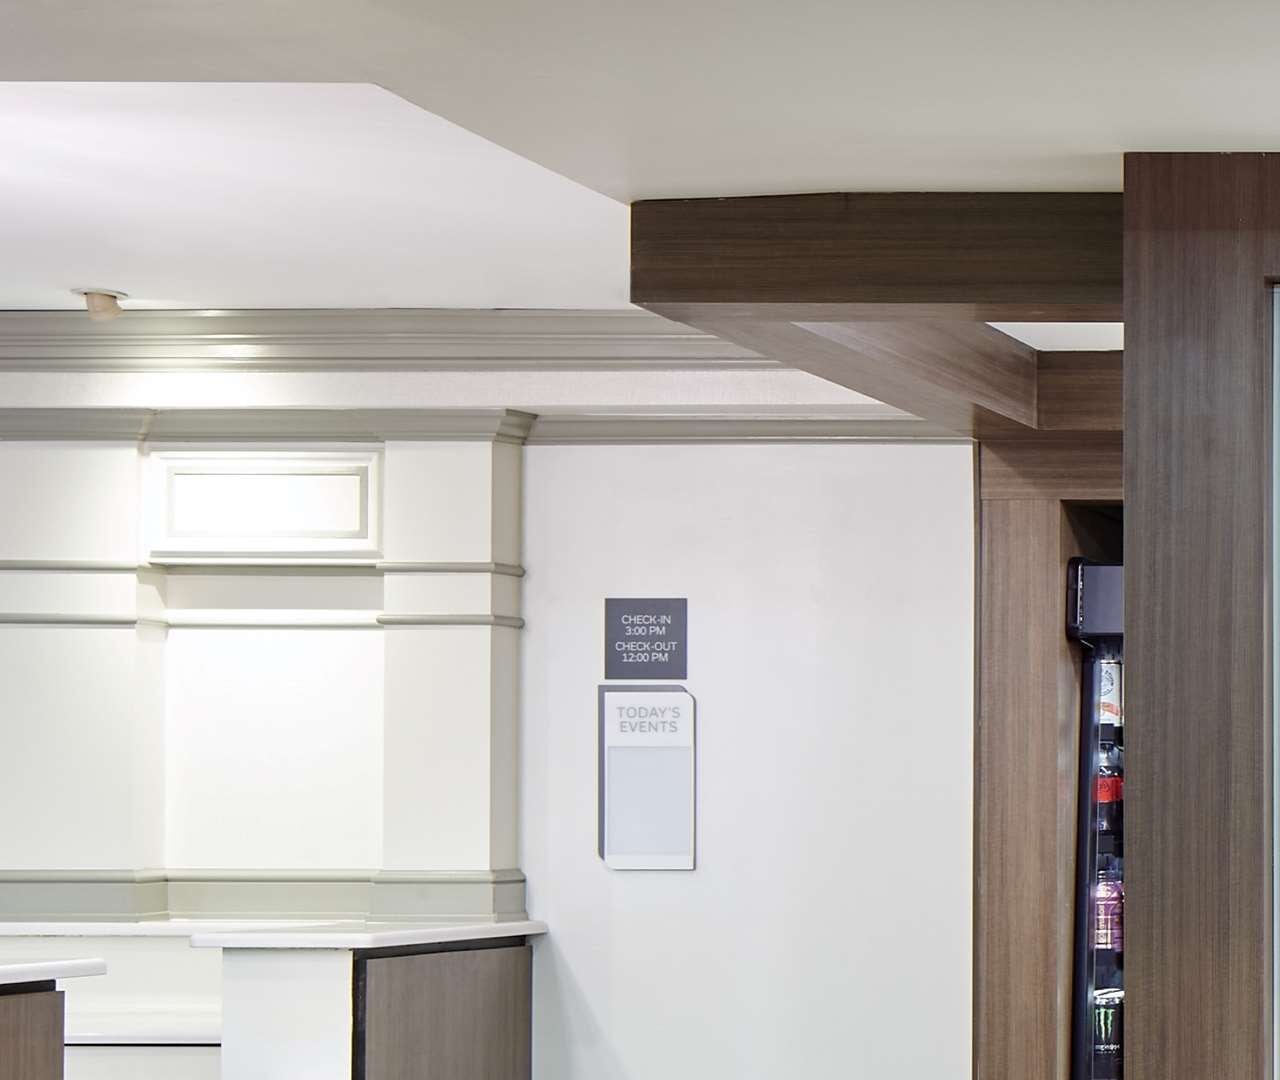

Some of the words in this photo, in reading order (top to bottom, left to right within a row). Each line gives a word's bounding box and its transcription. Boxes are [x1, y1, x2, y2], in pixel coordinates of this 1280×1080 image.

[621, 615, 672, 625] CHECK-IN
[625, 626, 647, 636] 3:00
[649, 626, 666, 636] PM
[615, 641, 678, 652] CHECK-OUT
[622, 653, 649, 663] 12:00
[651, 653, 669, 663] PM
[617, 706, 681, 719] TODAY'S
[620, 721, 678, 733] EVENTS
